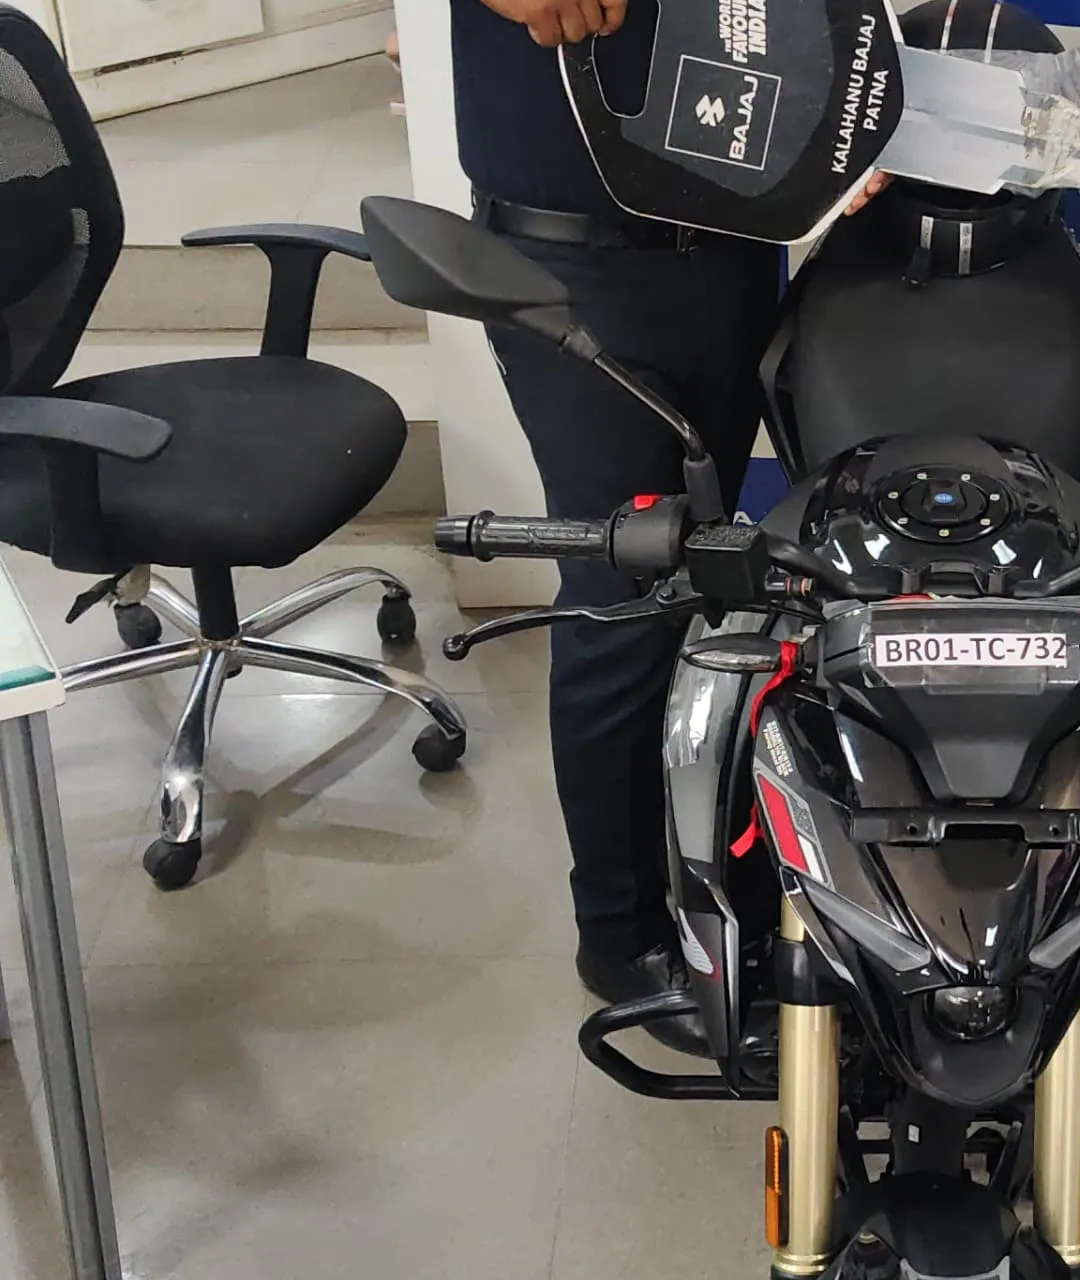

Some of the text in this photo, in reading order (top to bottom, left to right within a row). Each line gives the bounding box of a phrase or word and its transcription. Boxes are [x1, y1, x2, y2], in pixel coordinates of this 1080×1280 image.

[729, 75, 759, 160] BAJAJ
[831, 14, 876, 174] KALAHANU BAJAJ
[863, 70, 889, 131] PATNA
[885, 636, 1066, 663] BR01-TC-732
